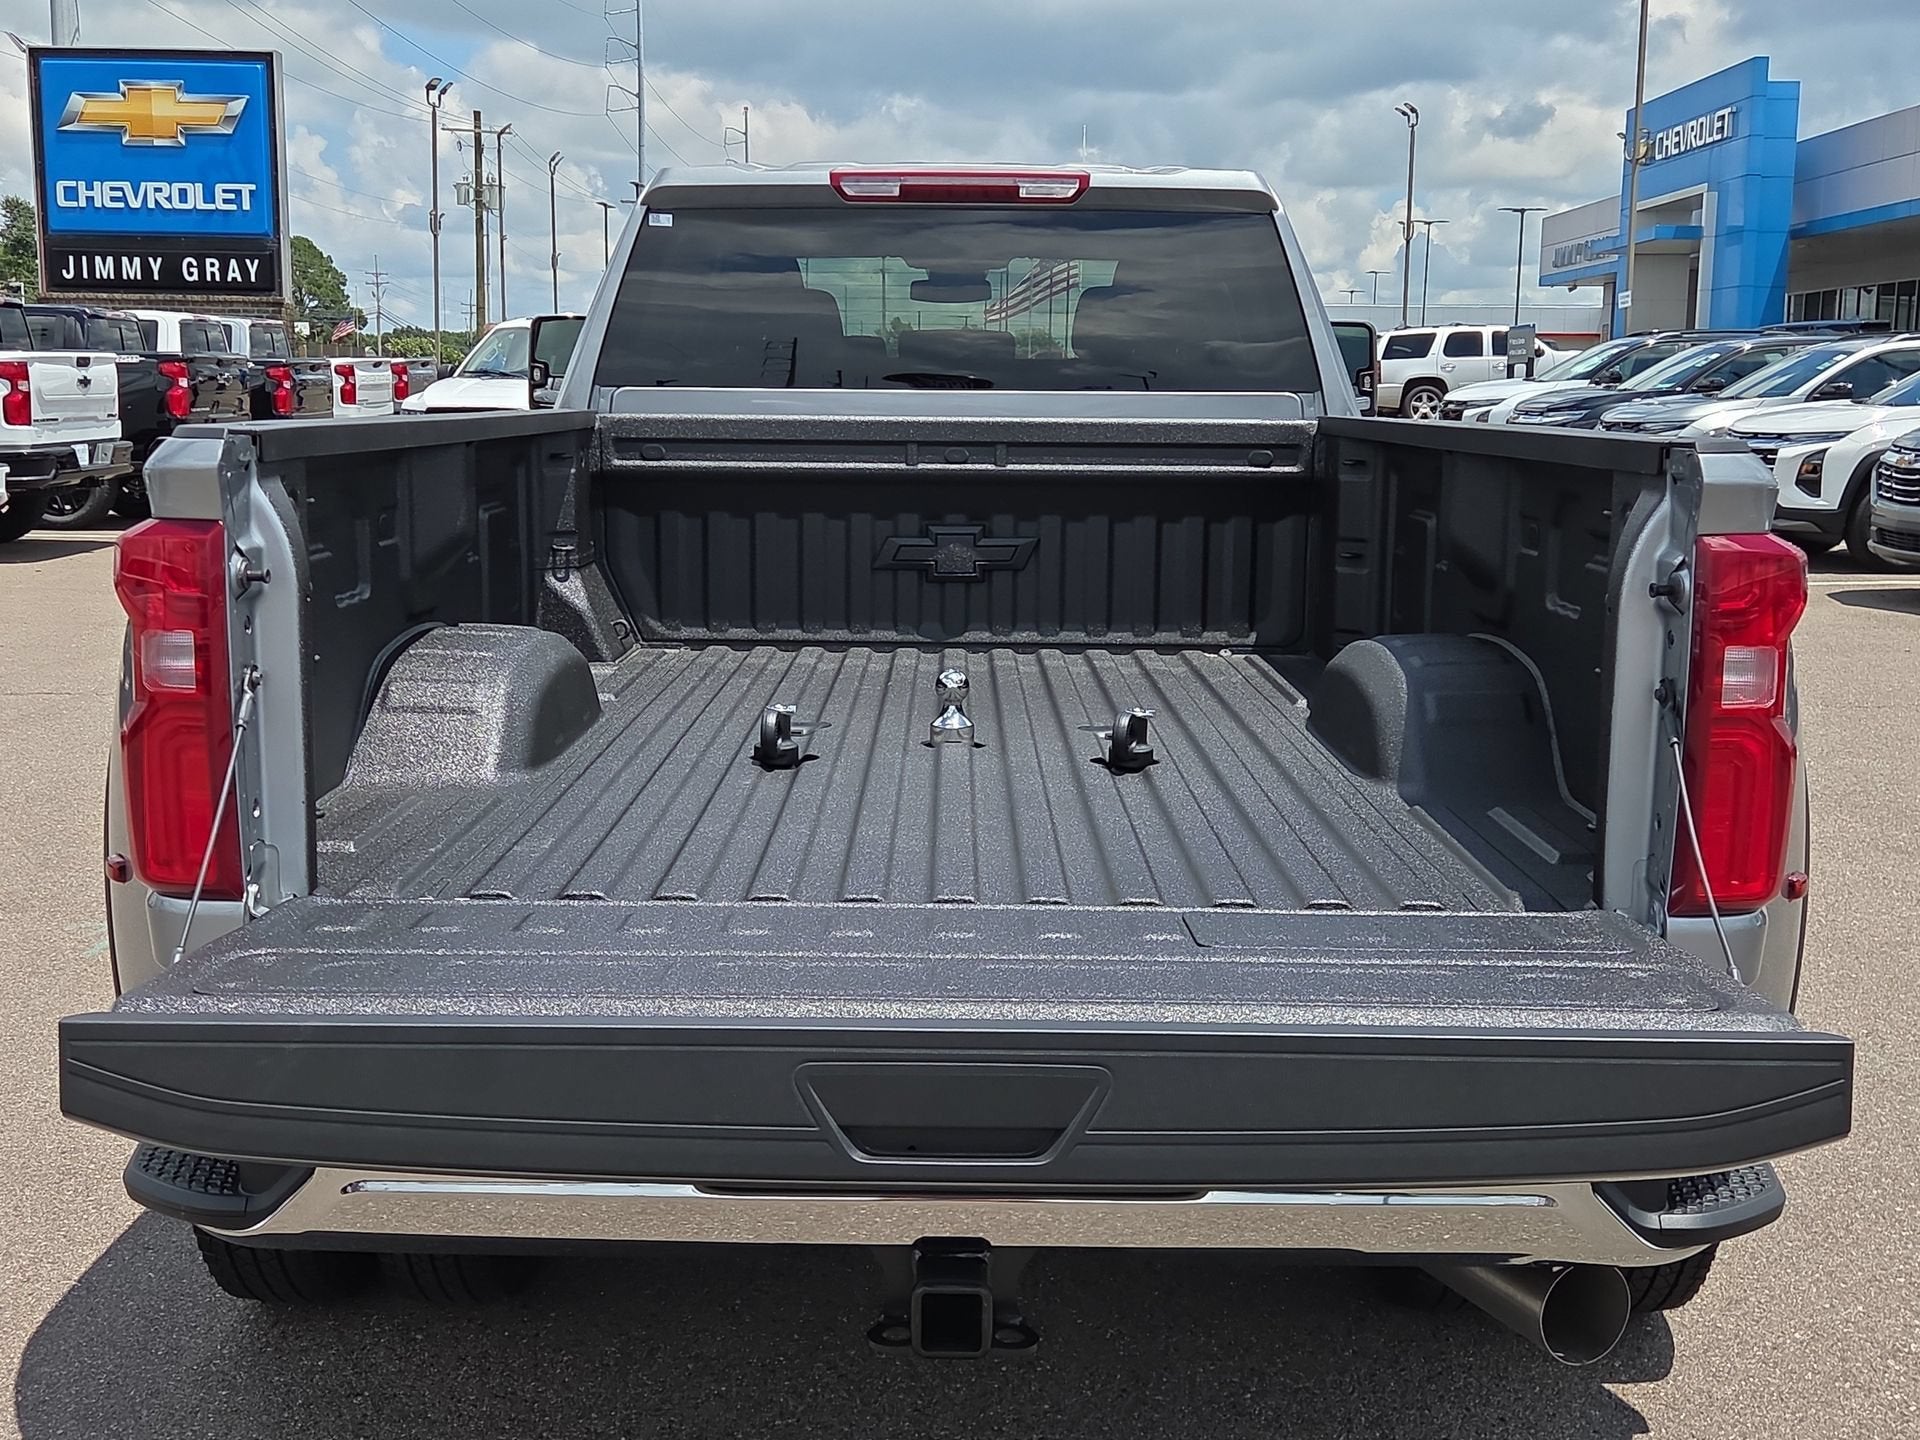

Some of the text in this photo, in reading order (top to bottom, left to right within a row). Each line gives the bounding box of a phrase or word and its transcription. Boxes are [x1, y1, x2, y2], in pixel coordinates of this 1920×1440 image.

[1655, 106, 1732, 160] CHEVROLET
[56, 180, 257, 211] CHEVROLET
[61, 255, 260, 283] JIMMY GRAY
